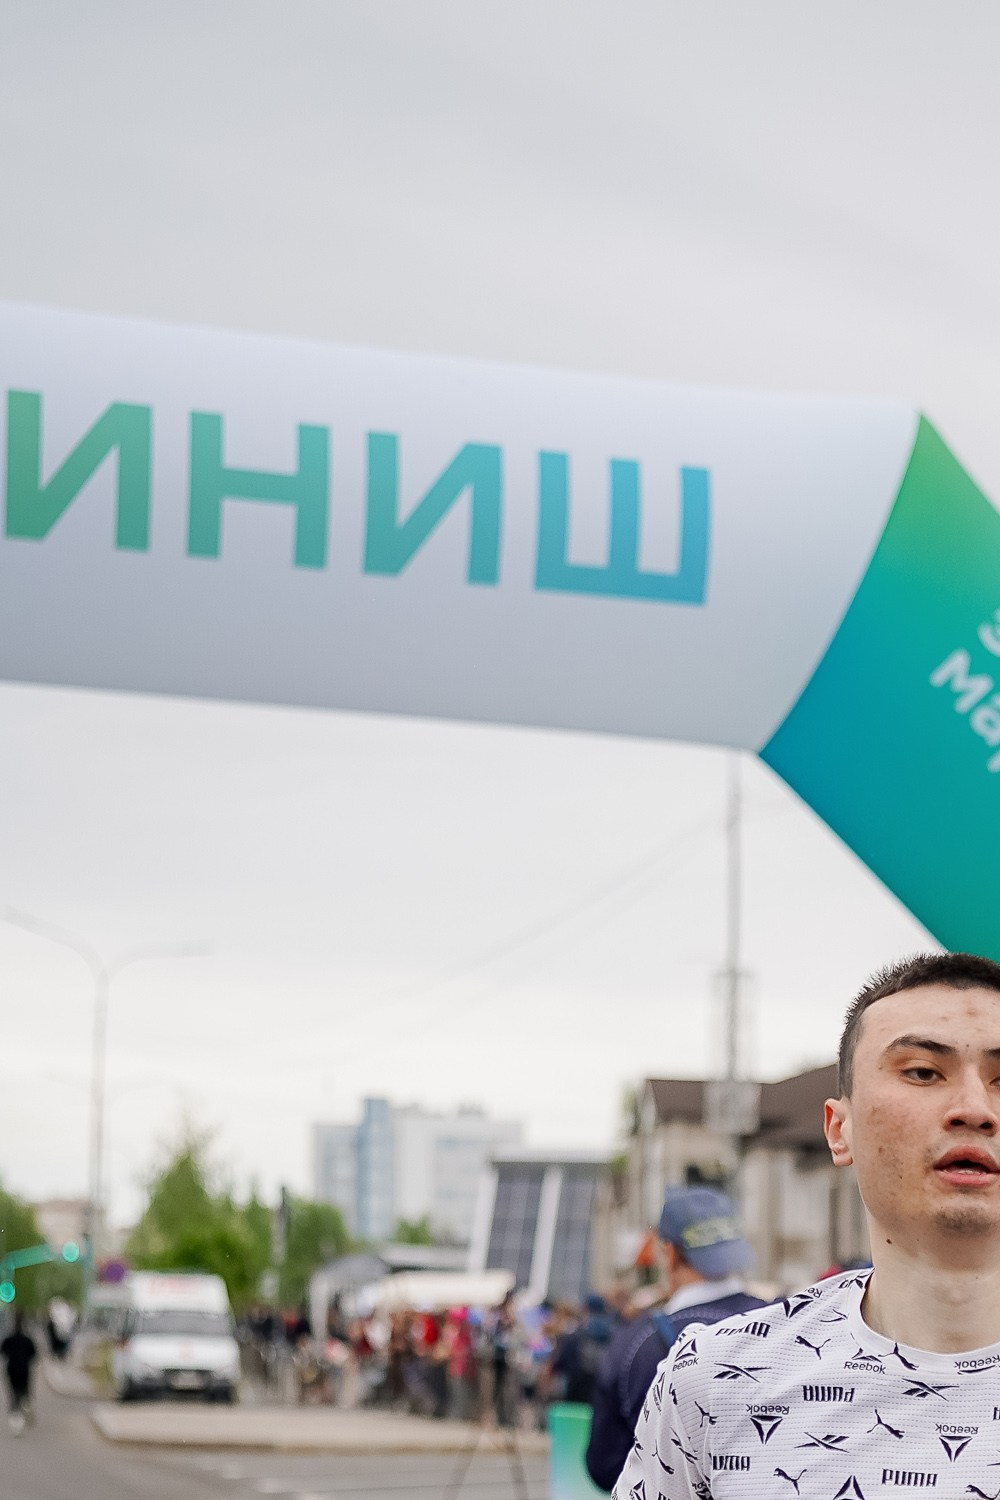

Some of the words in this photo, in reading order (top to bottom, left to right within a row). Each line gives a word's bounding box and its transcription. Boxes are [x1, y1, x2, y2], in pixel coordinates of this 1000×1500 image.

[672, 1357, 699, 1371] eebok
[844, 1361, 886, 1374] Reebok
[954, 1354, 1000, 1369] Reebok
[803, 1385, 855, 1402] PUMA
[746, 1404, 790, 1414] Reebok
[935, 1423, 979, 1434] Reebok
[711, 1455, 750, 1471] UMA
[882, 1468, 938, 1487] PUMA
